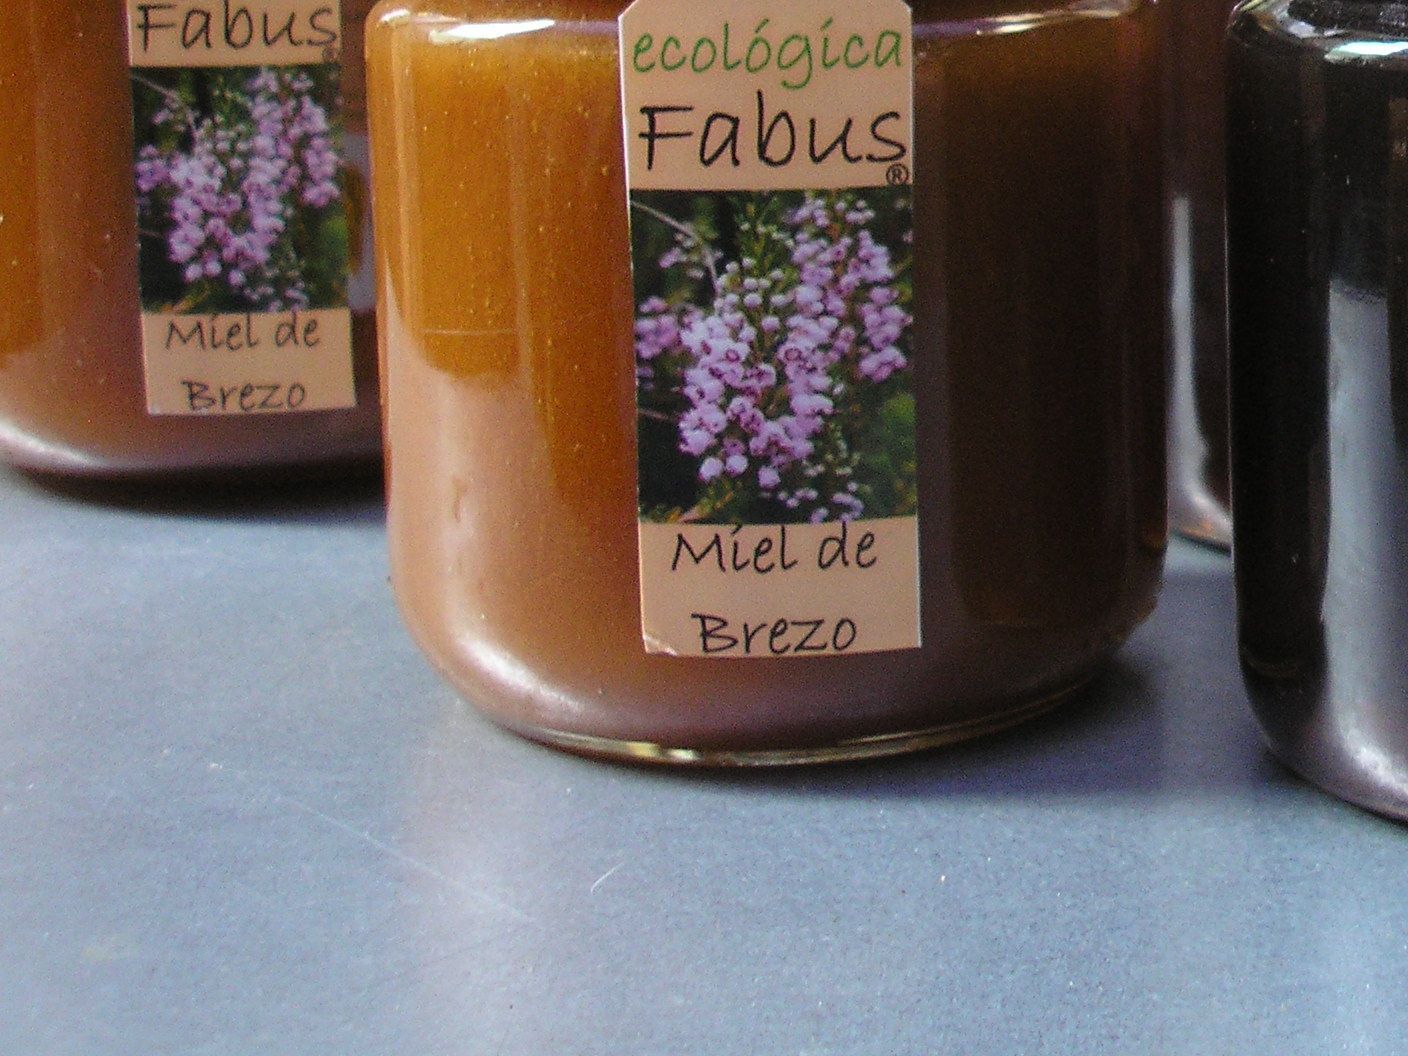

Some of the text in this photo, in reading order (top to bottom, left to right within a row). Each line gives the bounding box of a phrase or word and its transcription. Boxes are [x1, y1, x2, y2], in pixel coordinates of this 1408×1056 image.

[274, 310, 321, 348] de
[181, 378, 306, 411] Brezo
[817, 519, 878, 570] de
[691, 612, 857, 655] Brezo
